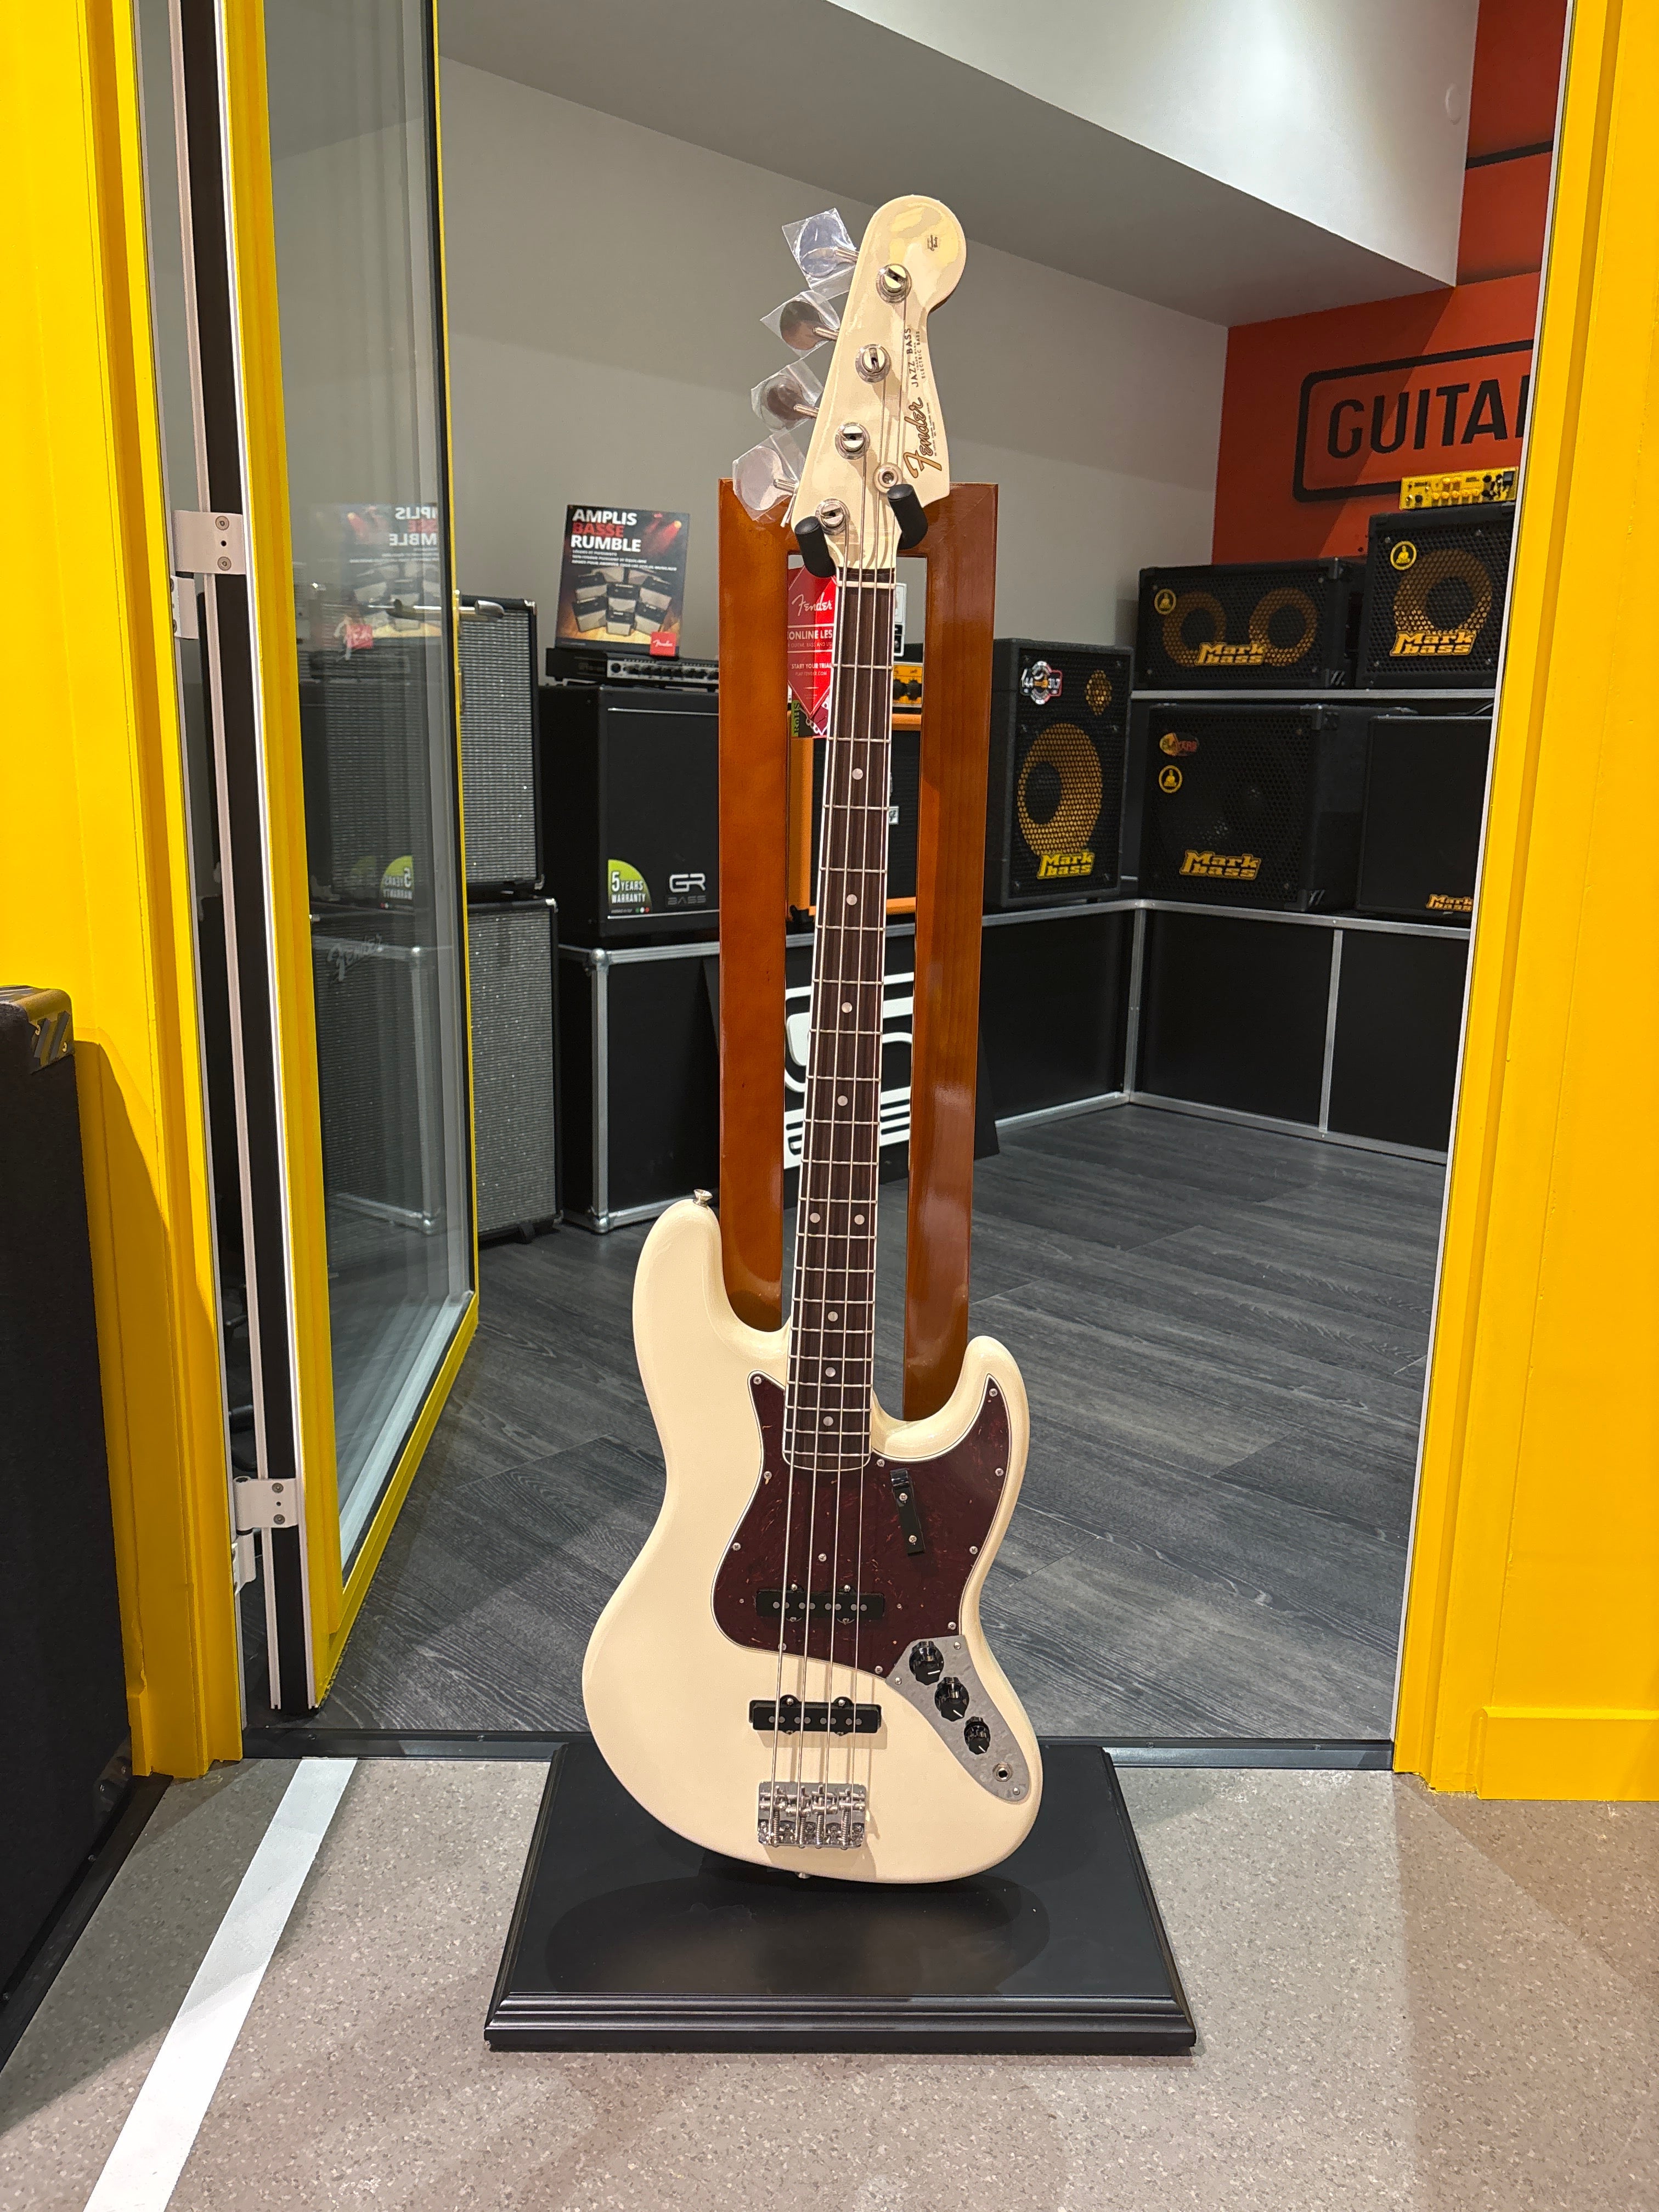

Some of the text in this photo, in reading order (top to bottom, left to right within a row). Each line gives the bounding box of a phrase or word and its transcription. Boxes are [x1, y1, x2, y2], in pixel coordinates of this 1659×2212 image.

[904, 328, 919, 387] JAZZ BASS
[917, 349, 926, 379] ELECTRIC
[903, 397, 942, 478] Fender
[572, 509, 637, 526] AMPLIS
[572, 522, 624, 538] BASSE
[571, 534, 641, 552] RUMBLE
[792, 591, 833, 617] Fender
[789, 630, 819, 640] ONLINE
[1391, 631, 1474, 654] Mark
[1197, 643, 1263, 663] Mark
[1206, 653, 1262, 663] bass
[1402, 644, 1471, 654] bass
[1039, 852, 1092, 877] Mark
[1046, 865, 1092, 876] bass
[1181, 852, 1259, 872] Mark
[1190, 863, 1256, 878] bass
[611, 871, 644, 892] 5 YEARS
[669, 873, 706, 893] GR
[611, 892, 646, 904] WARRANTY
[668, 895, 707, 905] BASS
[1429, 895, 1474, 908] Mark
